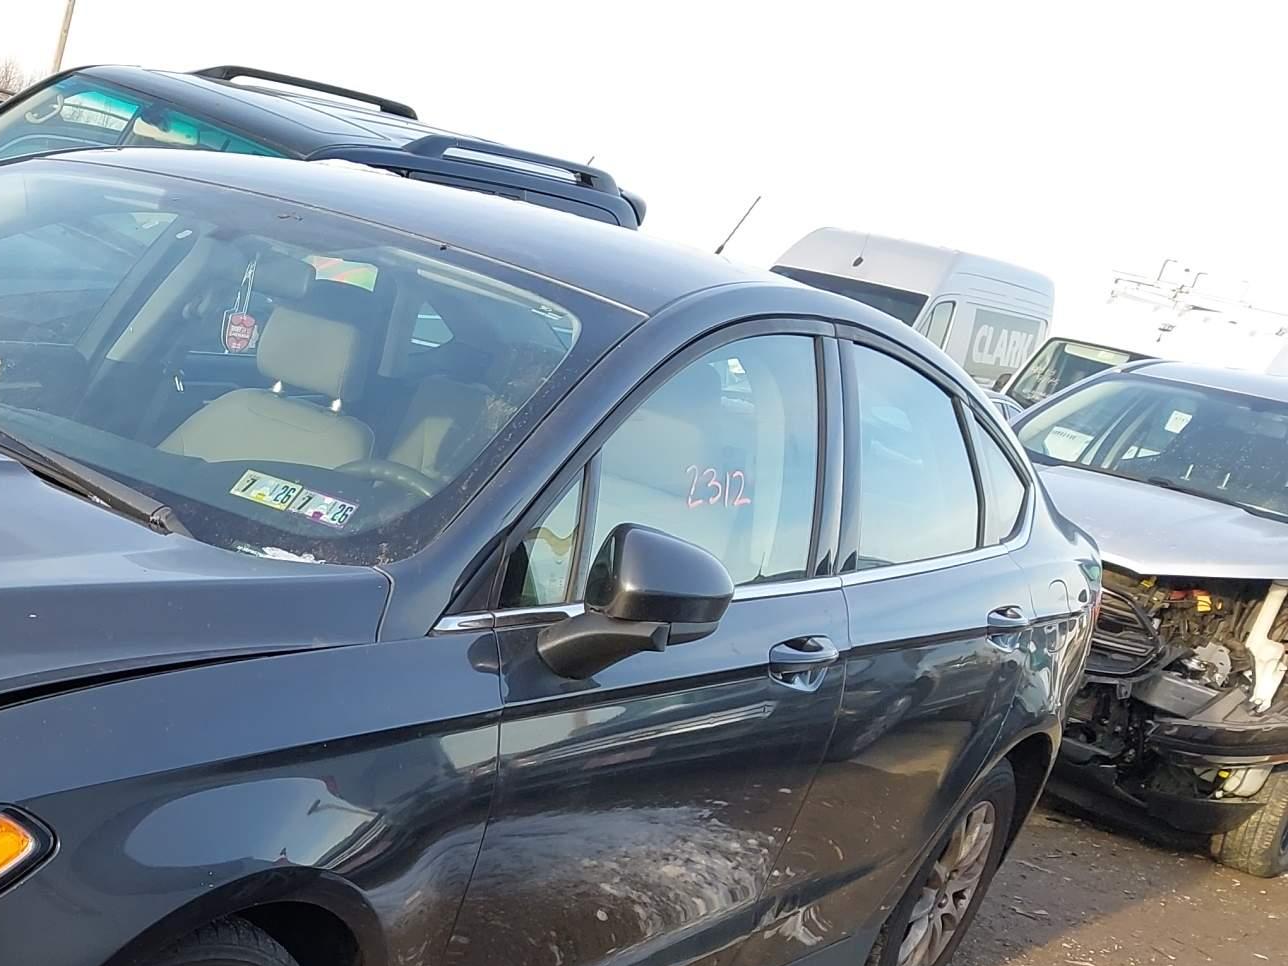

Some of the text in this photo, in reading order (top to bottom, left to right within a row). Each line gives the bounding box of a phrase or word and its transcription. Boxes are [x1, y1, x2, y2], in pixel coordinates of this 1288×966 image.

[972, 324, 1034, 369] CLARK
[241, 478, 297, 504] 7 26
[686, 464, 752, 509] 2312
[297, 495, 355, 524] 7 26
